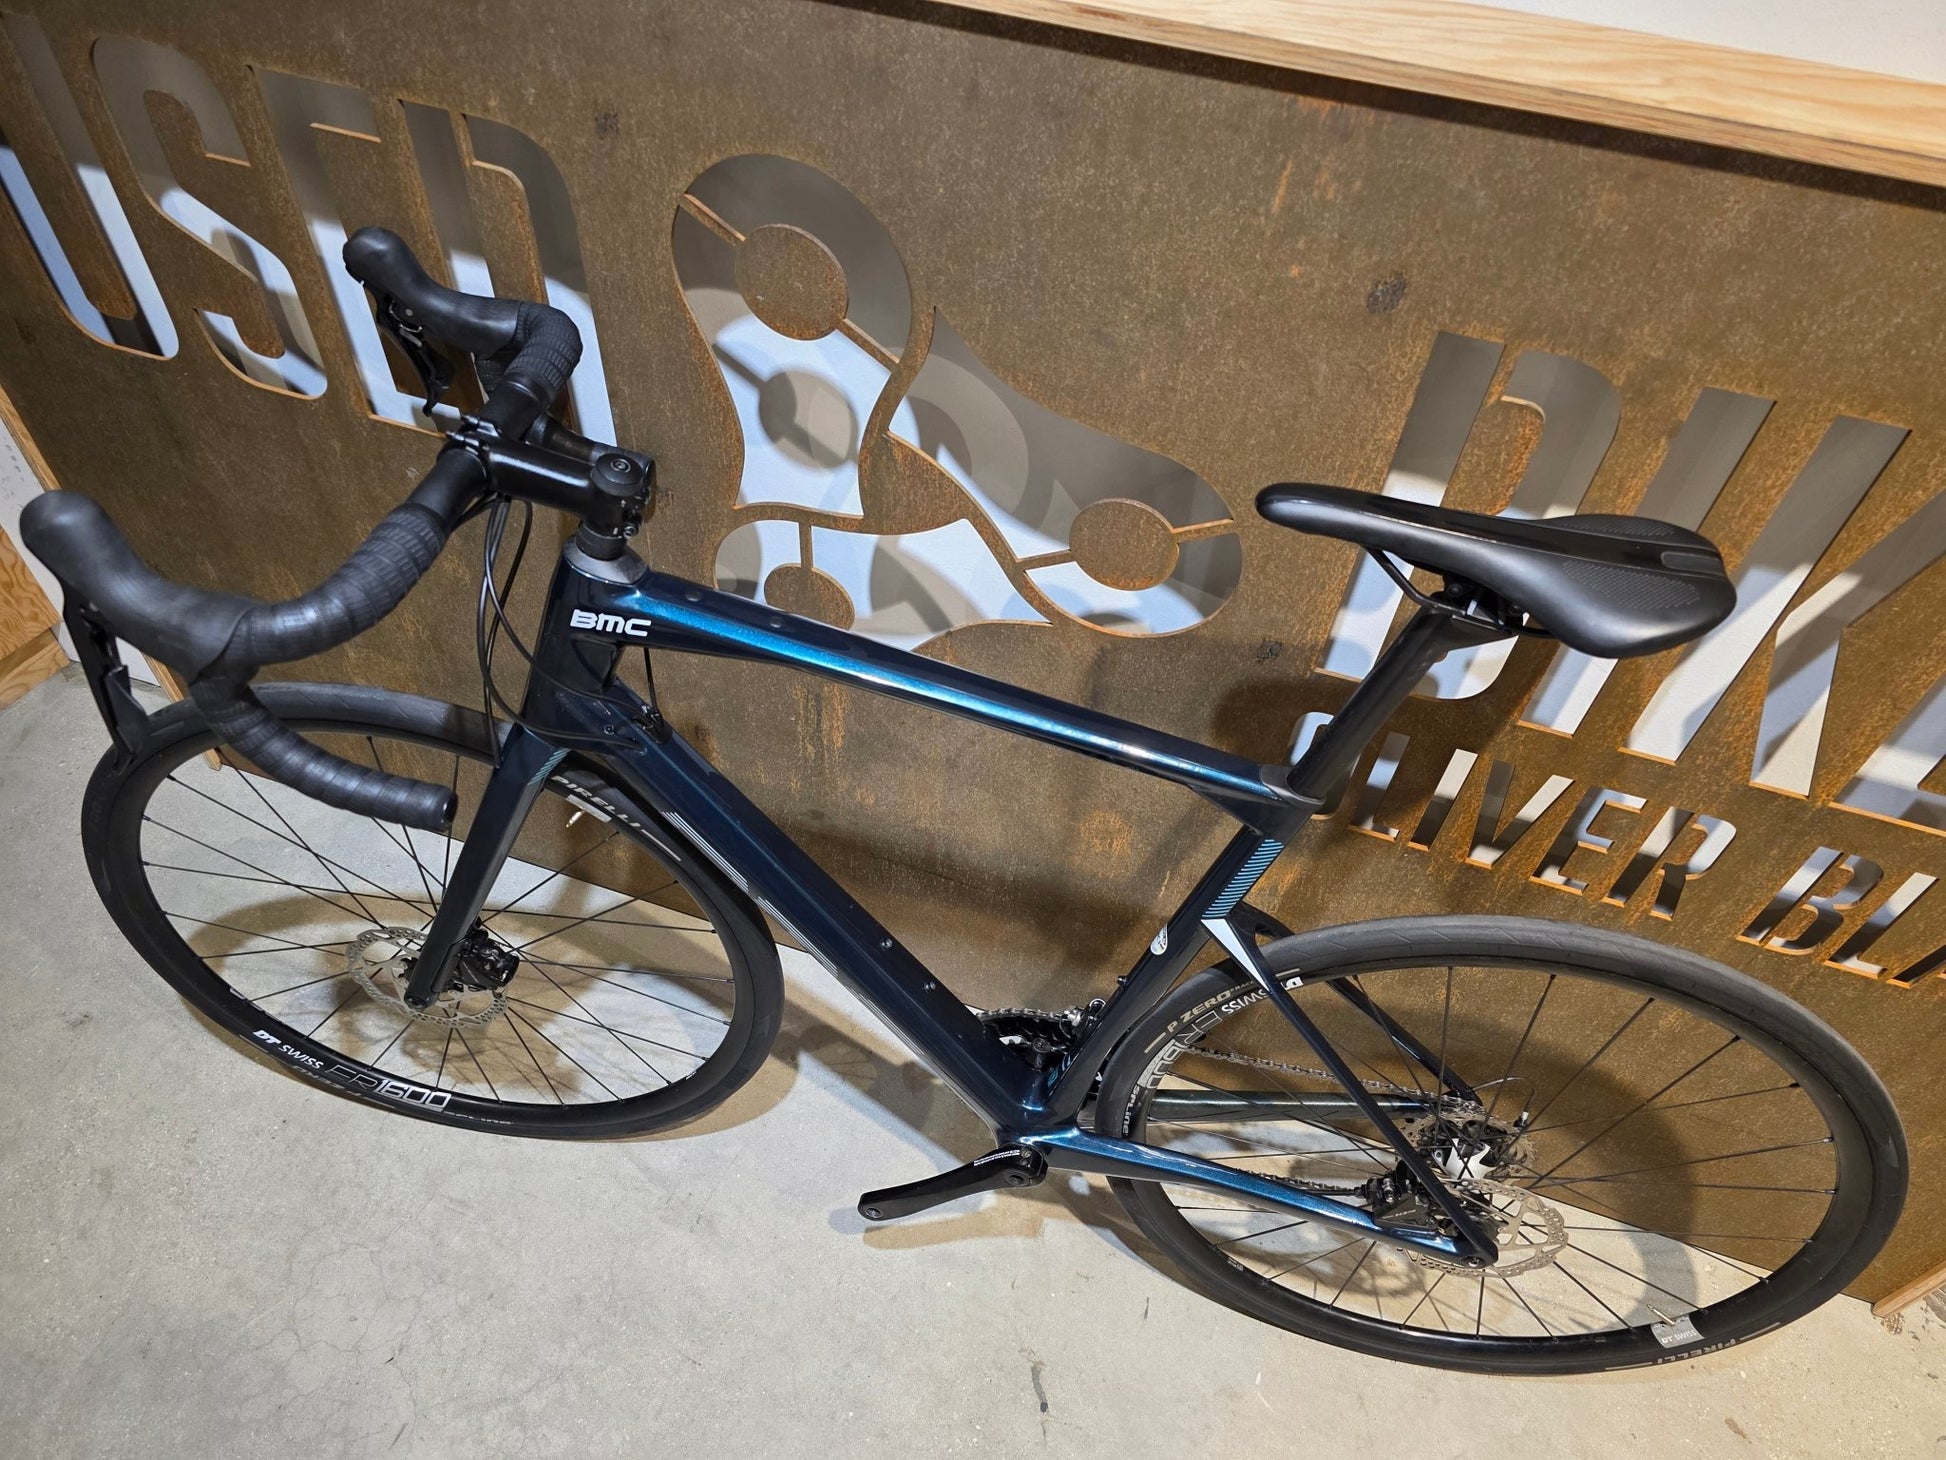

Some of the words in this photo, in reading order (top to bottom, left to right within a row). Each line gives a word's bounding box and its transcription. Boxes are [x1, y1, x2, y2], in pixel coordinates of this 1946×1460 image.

[1314, 330, 1946, 836] BIK
[570, 608, 652, 637] BMC
[551, 775, 641, 827] PIRELLI
[1167, 1021, 1179, 1033] P
[1180, 990, 1231, 1023] ZERO
[1221, 988, 1268, 1014] SWISS
[252, 1029, 281, 1045] DT
[279, 1043, 324, 1070] SWISS
[1657, 1338, 1736, 1364] PIRELLI
[1661, 1335, 1674, 1344] DT
[1675, 1330, 1697, 1341] SWISS
